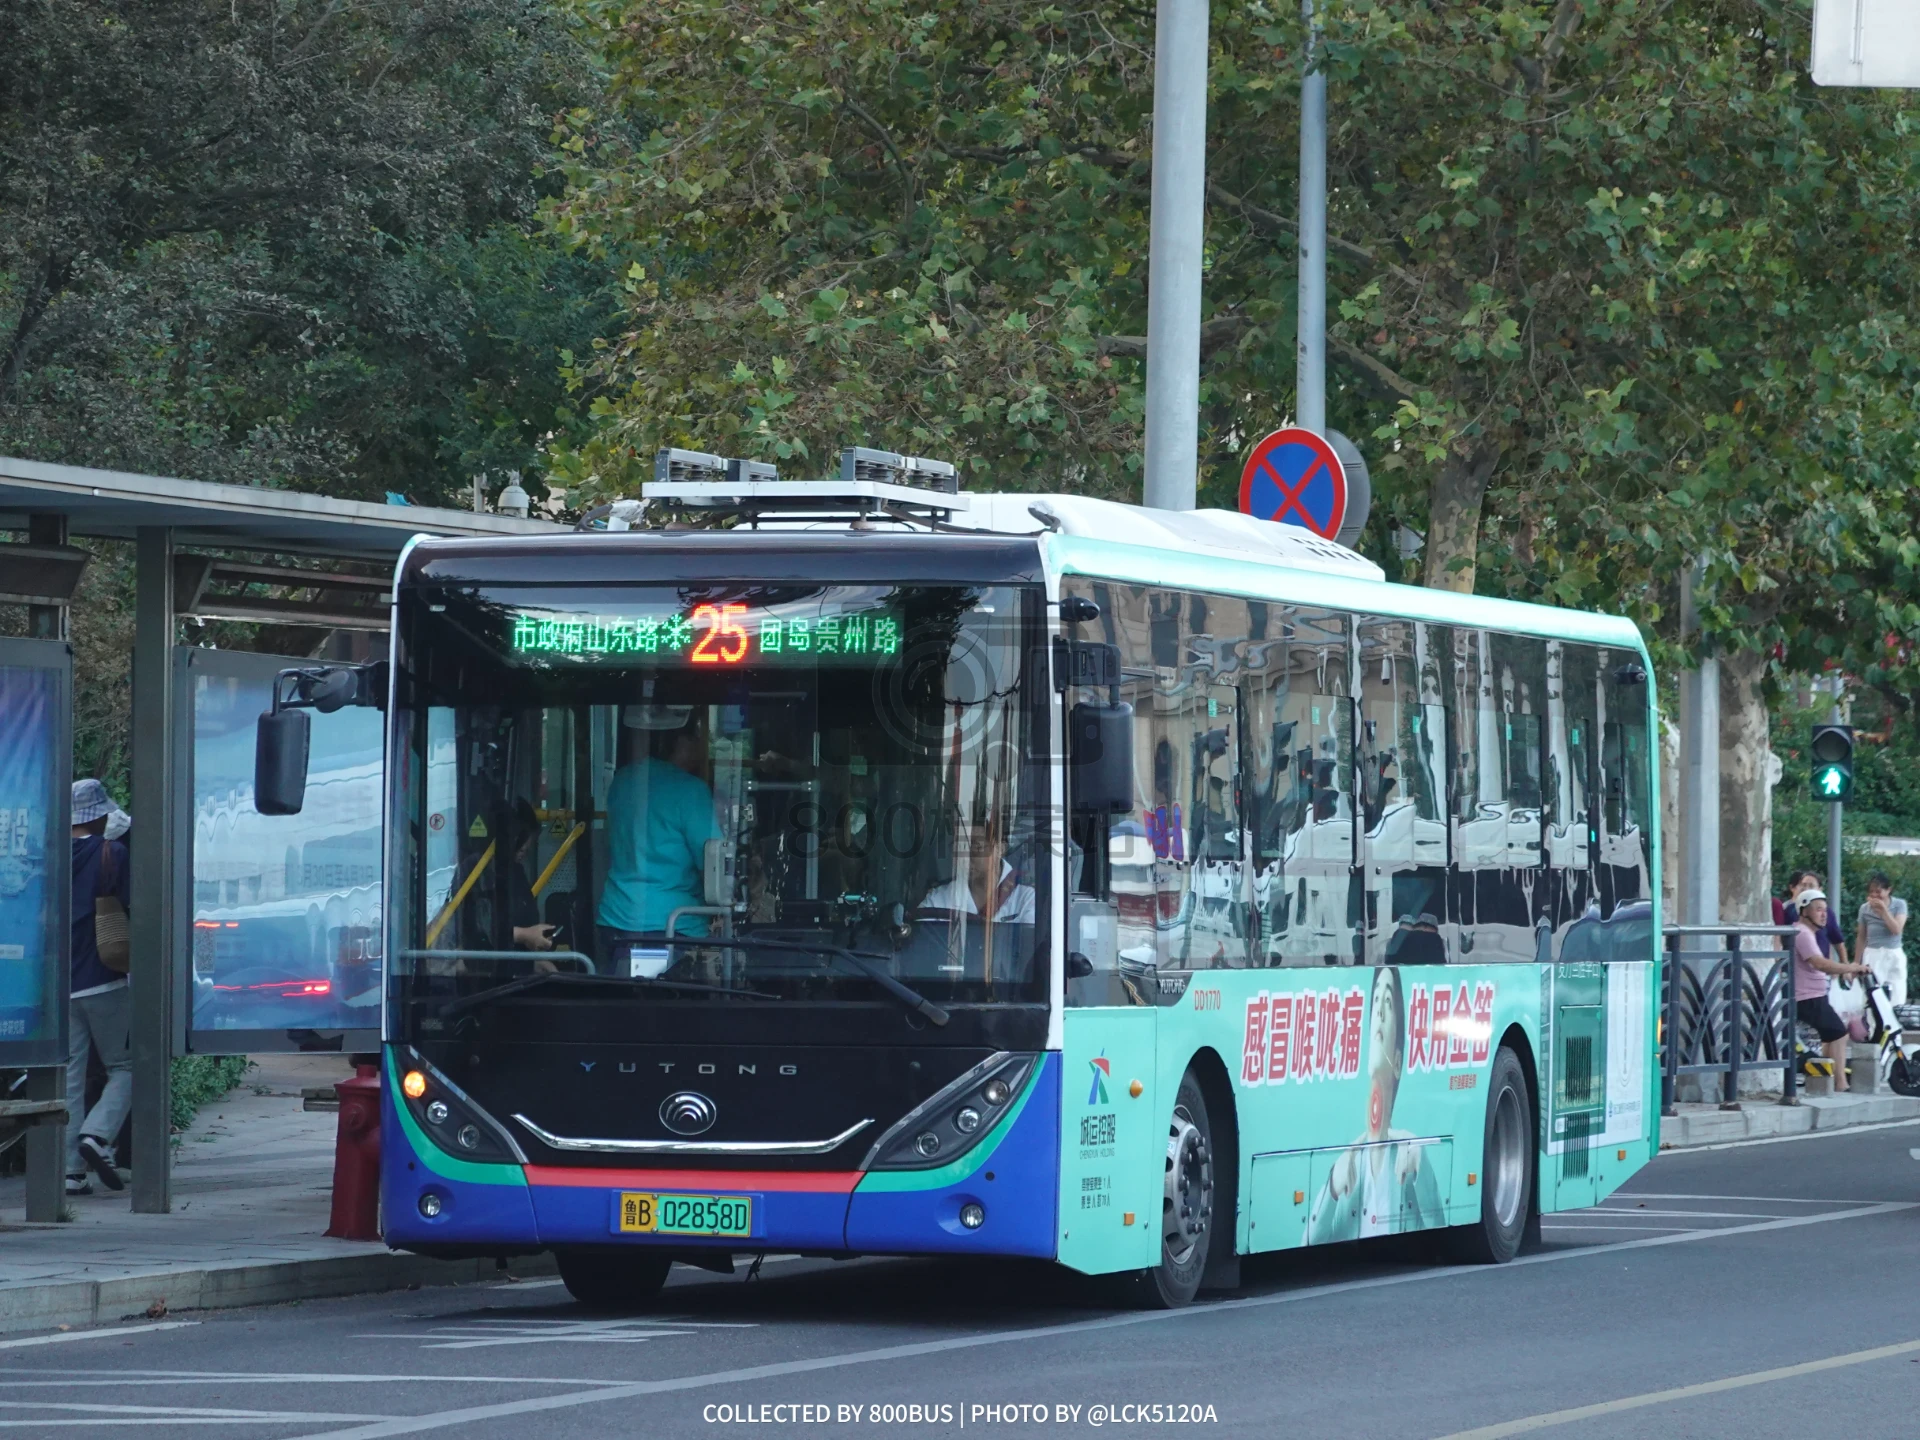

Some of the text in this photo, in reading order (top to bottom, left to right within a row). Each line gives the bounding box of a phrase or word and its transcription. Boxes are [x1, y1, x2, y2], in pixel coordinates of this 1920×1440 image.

[513, 603, 900, 663] 市政府山东路 25 团岛贵州路
[1194, 990, 1221, 1010] DD1770
[579, 1061, 798, 1075] YUTONG
[1080, 1114, 1116, 1147] 城运控股
